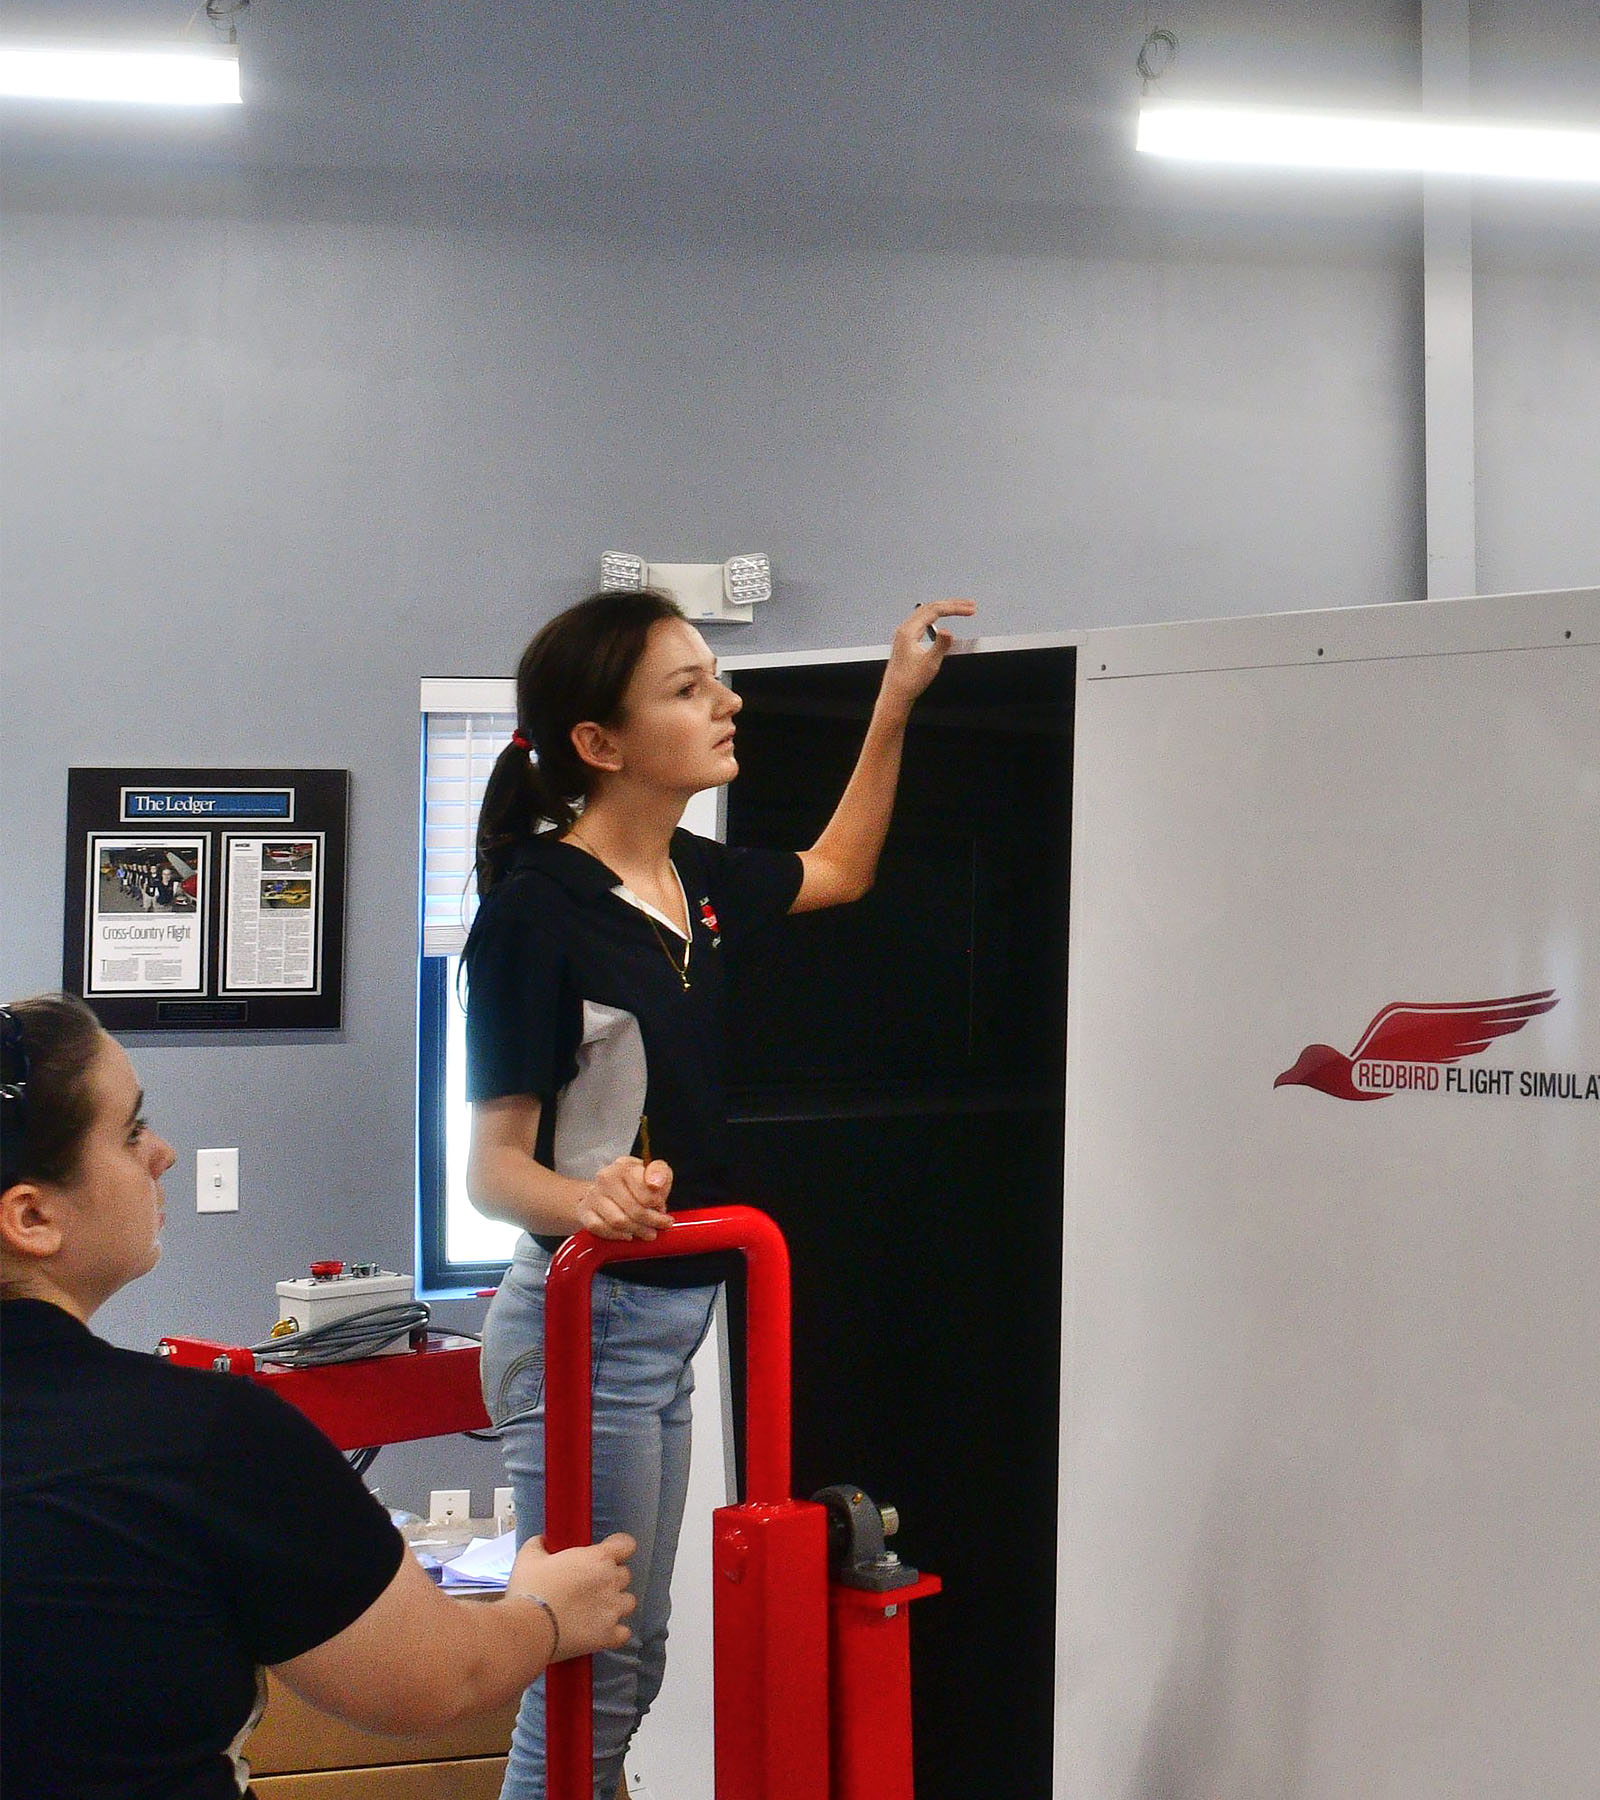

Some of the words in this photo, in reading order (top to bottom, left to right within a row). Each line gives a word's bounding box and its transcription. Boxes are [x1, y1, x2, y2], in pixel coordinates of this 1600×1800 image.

[135, 796, 164, 812] The
[165, 796, 216, 814] Ledger
[103, 926, 165, 941] Cross-Country
[167, 925, 192, 942] Flight
[1358, 1063, 1440, 1091] REDBIRD
[1445, 1068, 1515, 1097] FLIGHT
